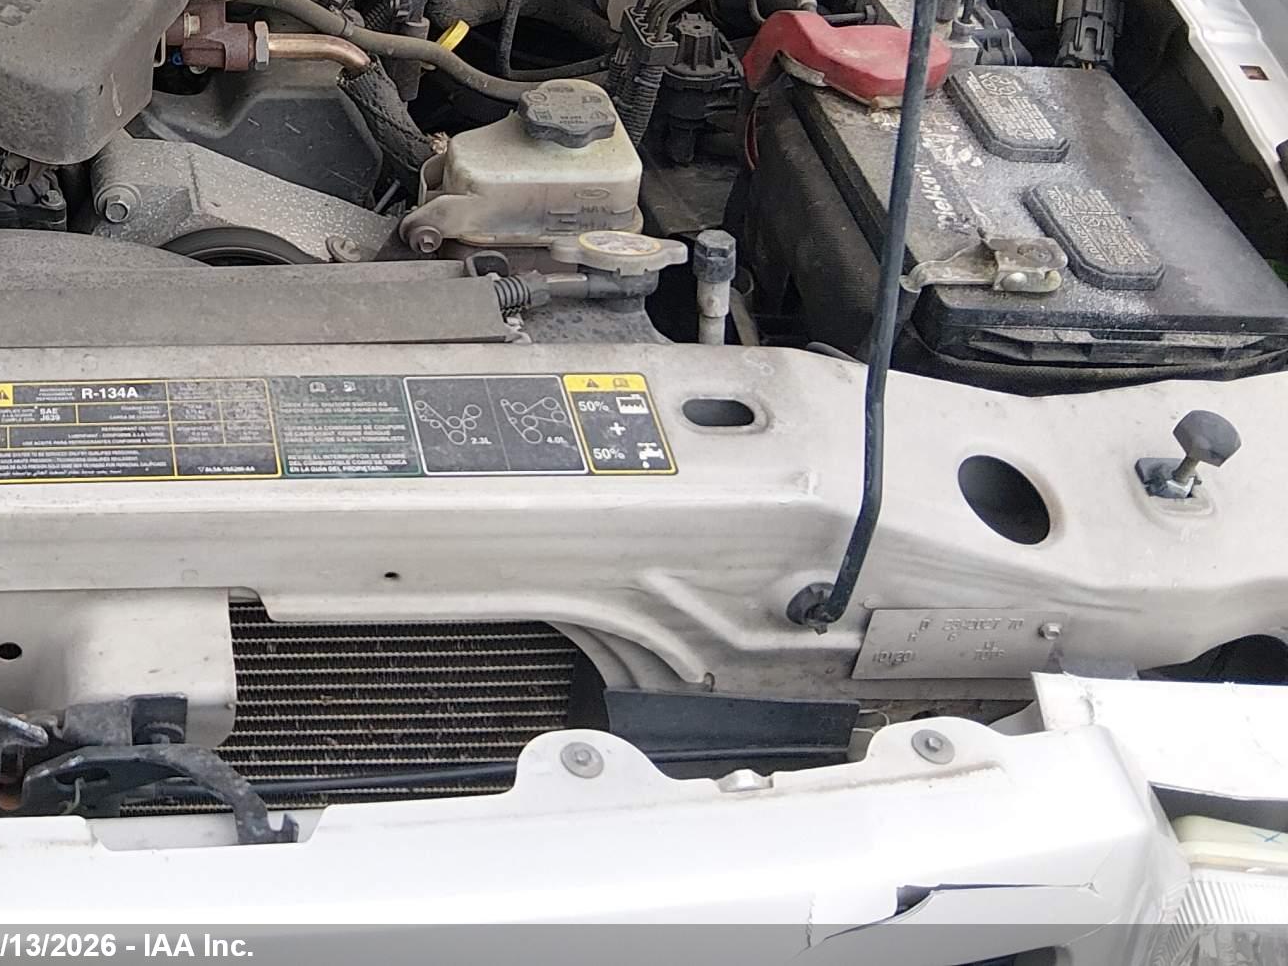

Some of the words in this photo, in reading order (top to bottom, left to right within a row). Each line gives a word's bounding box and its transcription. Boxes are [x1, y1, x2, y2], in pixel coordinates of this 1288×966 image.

[81, 387, 138, 399] R-134A
[578, 399, 609, 412] 50%
[470, 436, 492, 445] 2.3L
[546, 435, 568, 445] 4.0L
[593, 446, 625, 461] 50%
